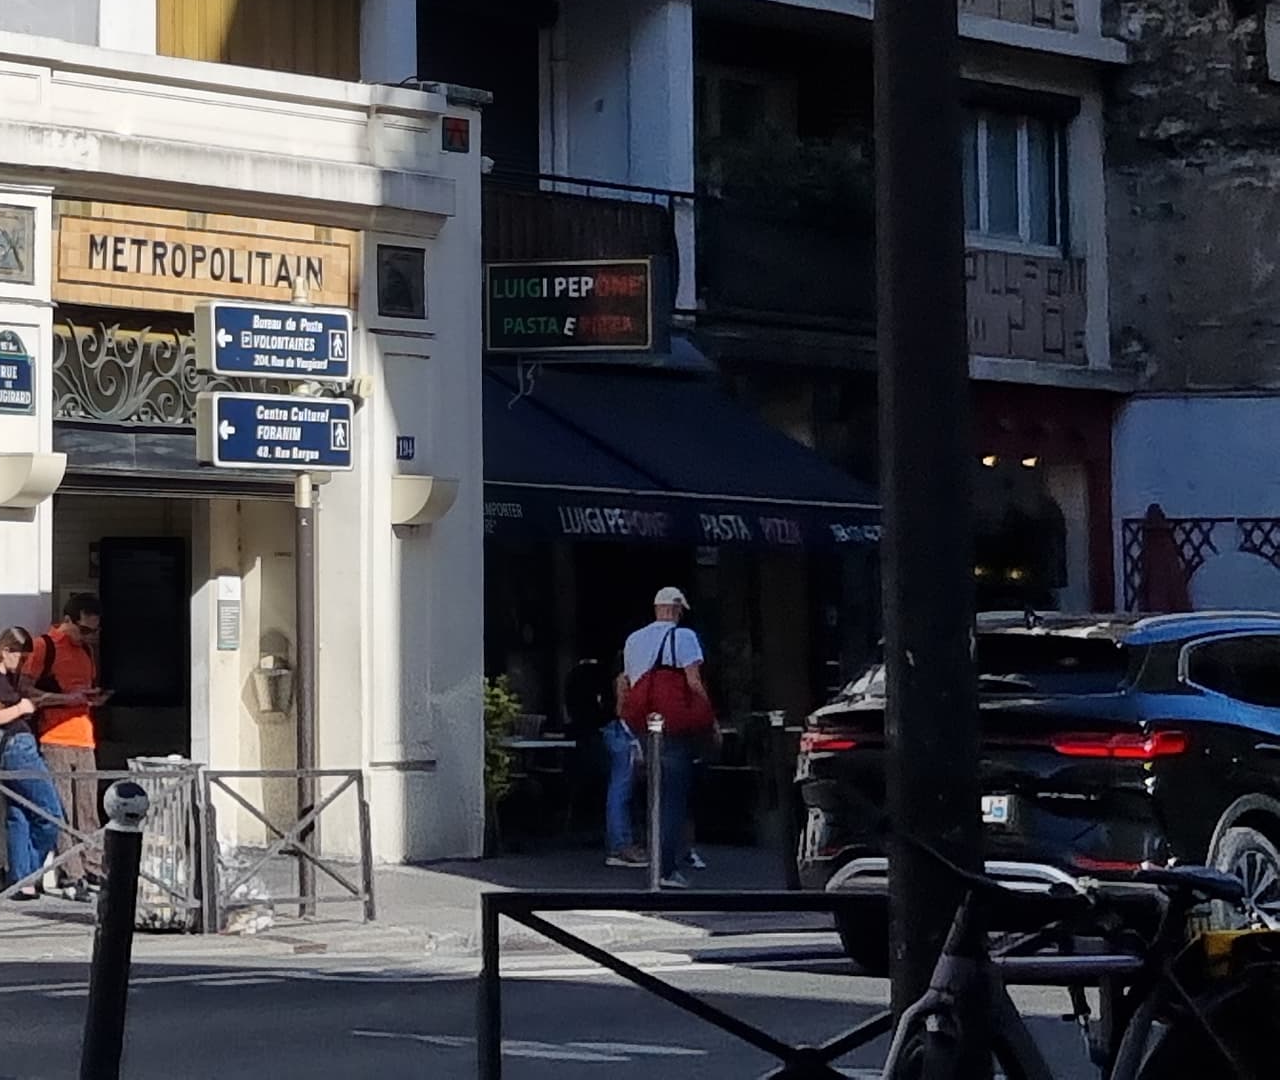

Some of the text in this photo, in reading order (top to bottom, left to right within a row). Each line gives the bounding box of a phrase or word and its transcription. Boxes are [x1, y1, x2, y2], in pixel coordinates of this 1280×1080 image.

[88, 233, 324, 292] METROPOLITAIN
[493, 277, 548, 298] LUIGI
[252, 314, 323, 333] Bureau de Poste
[503, 316, 561, 335] PASTA
[563, 317, 577, 336] E
[253, 335, 316, 352] VOLONTAIRES
[271, 355, 285, 367] Rue
[0, 364, 18, 379] RUE
[255, 405, 330, 423] Centre Culturel
[256, 425, 302, 441] FORANIM
[274, 446, 291, 459] Rue
[484, 501, 523, 519] MPORTER
[558, 506, 605, 534] LUIGI
[699, 514, 752, 542] PASTA
